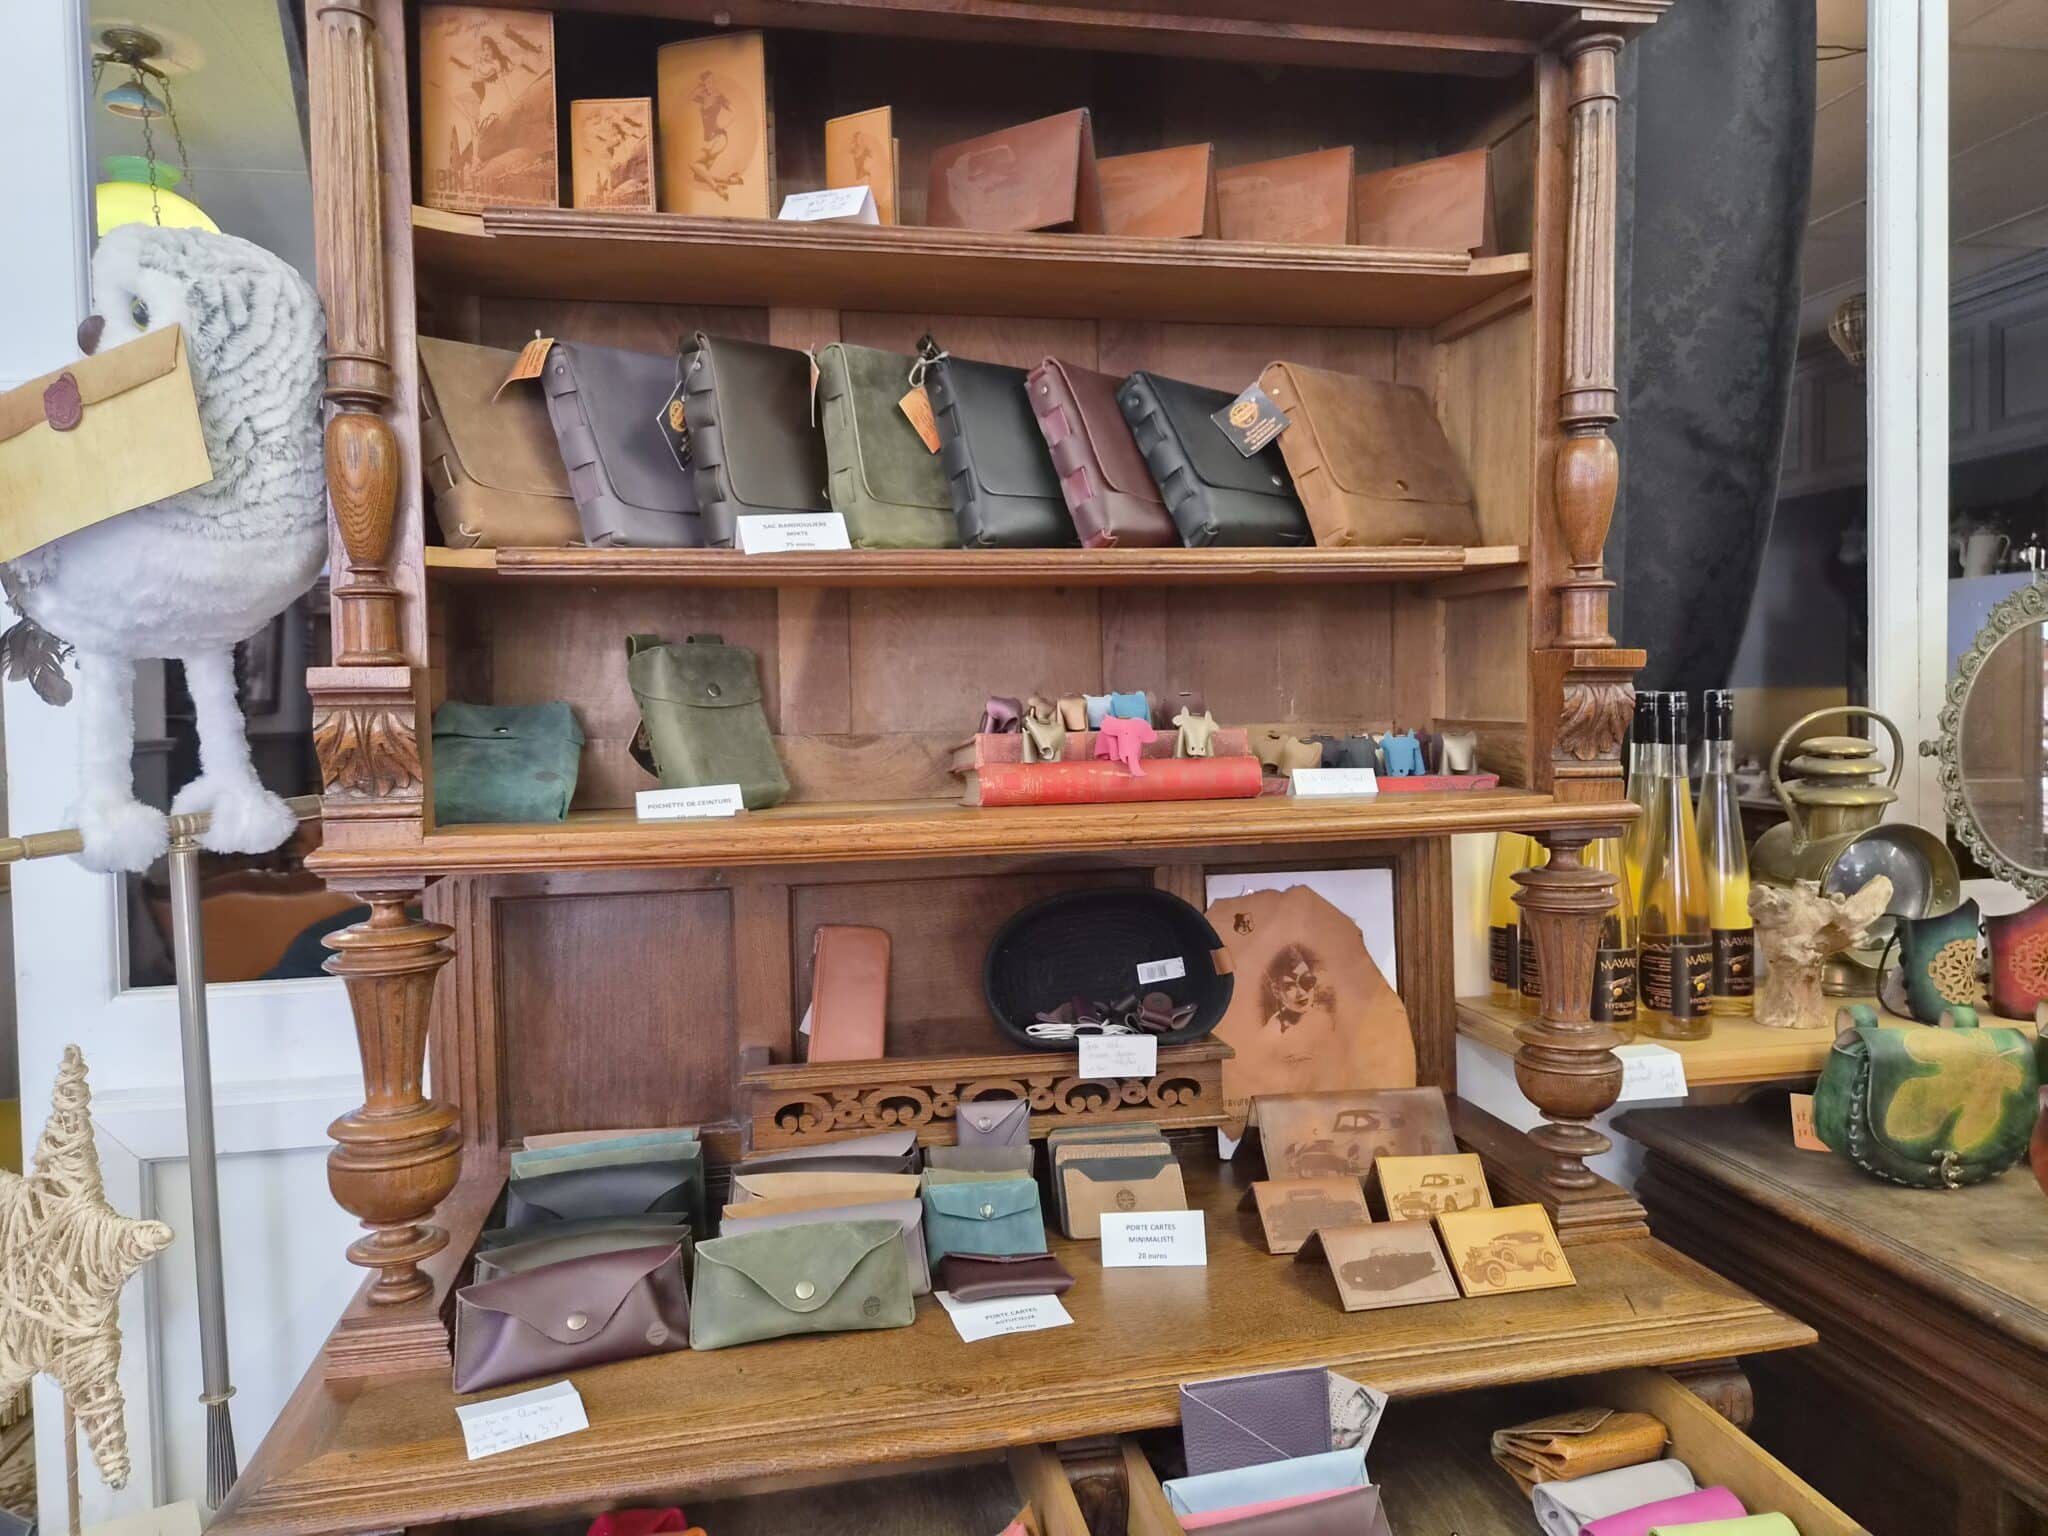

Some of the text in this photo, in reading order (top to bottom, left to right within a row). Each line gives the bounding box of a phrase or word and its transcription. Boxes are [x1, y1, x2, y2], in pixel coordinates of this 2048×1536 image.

[647, 802, 684, 810] POCHETTE
[1150, 1223, 1177, 1231] CARTES
[985, 1312, 1008, 1320] PORTE
